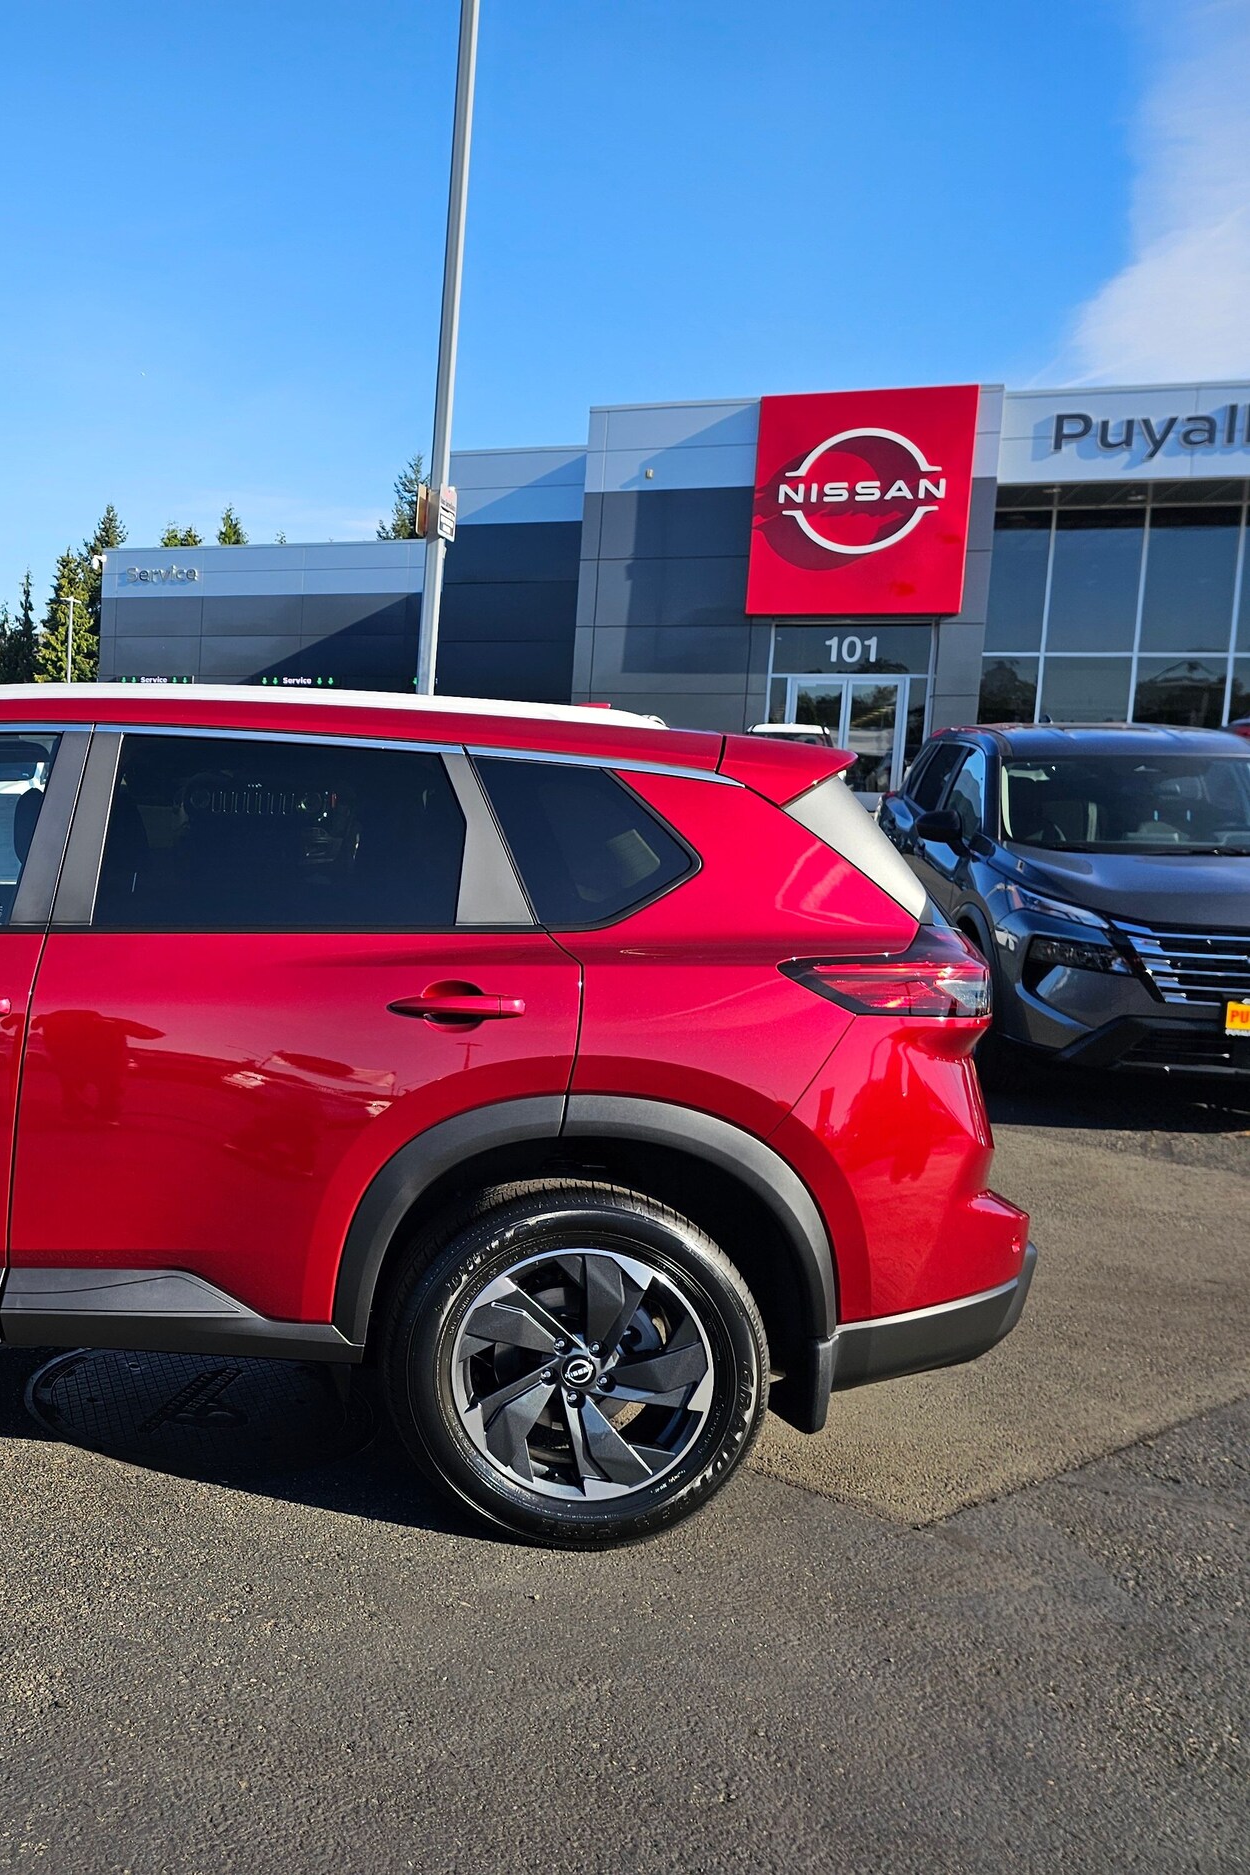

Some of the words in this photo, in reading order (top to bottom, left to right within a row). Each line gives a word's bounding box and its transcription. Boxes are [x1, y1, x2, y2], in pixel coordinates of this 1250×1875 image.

[778, 478, 946, 504] NISSAN
[126, 565, 198, 583] Service
[825, 636, 878, 663] 101
[282, 677, 312, 685] Service
